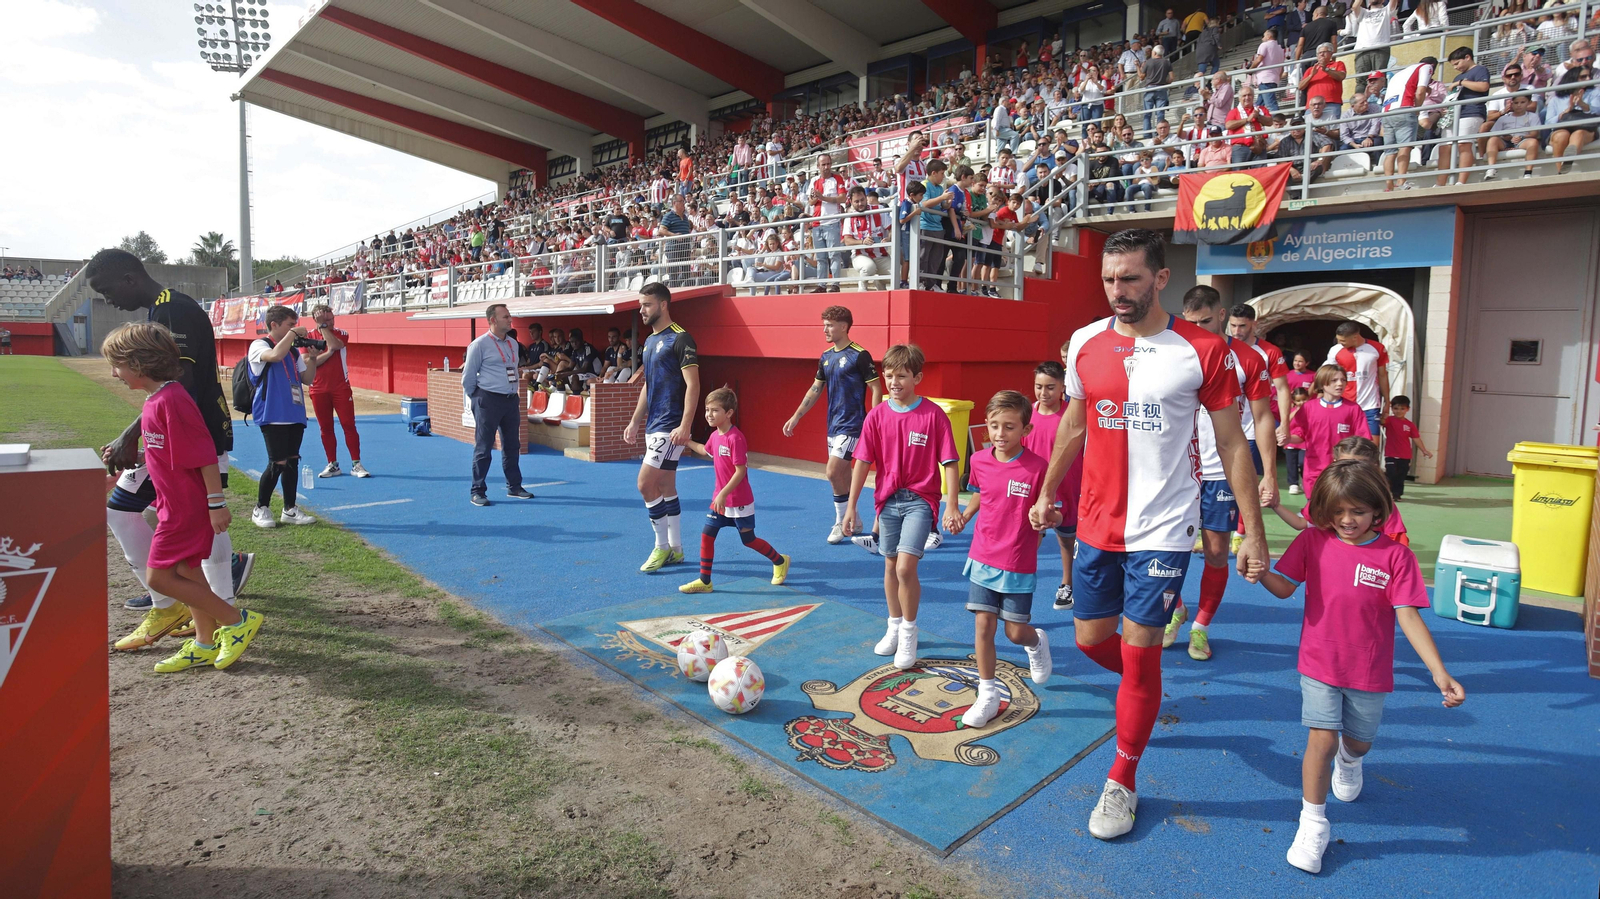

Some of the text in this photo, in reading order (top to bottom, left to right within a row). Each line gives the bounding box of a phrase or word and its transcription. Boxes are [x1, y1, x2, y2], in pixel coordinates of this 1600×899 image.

[1291, 200, 1315, 208] SALIDA
[1283, 229, 1394, 248] Ayuntamiento
[1281, 244, 1393, 264] de Algeciras
[1123, 402, 1162, 419] 威视
[648, 436, 667, 454] 22
[1360, 564, 1391, 581] bandera
